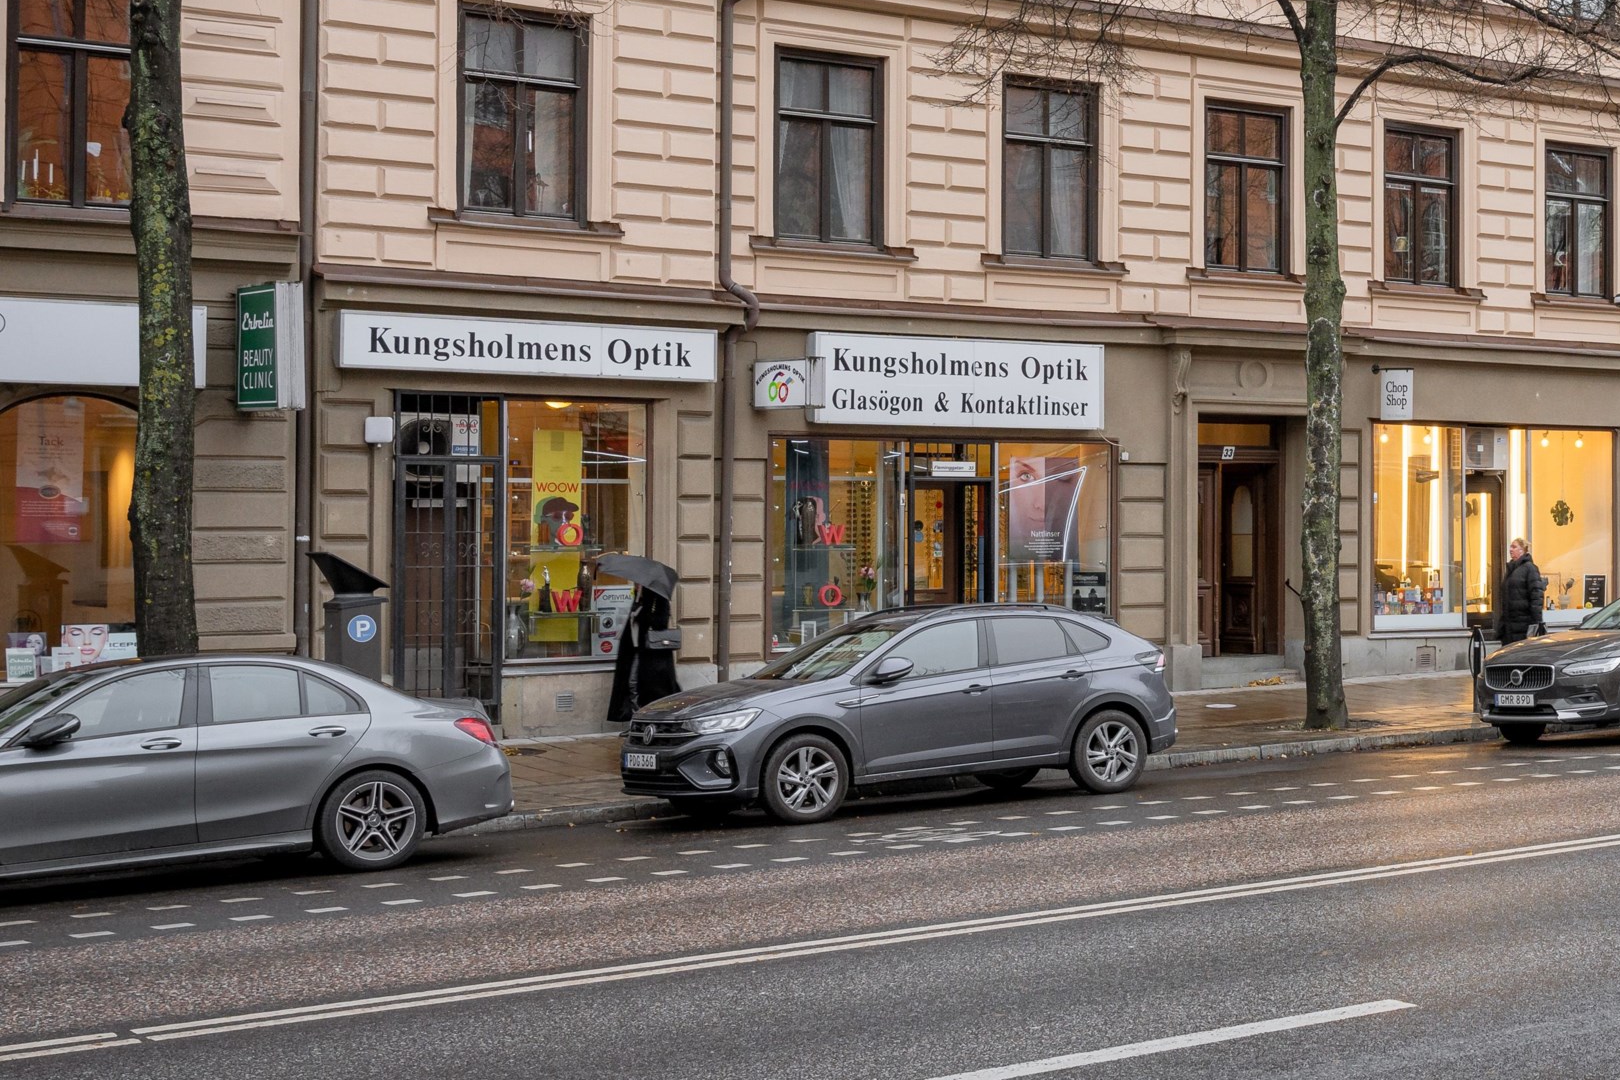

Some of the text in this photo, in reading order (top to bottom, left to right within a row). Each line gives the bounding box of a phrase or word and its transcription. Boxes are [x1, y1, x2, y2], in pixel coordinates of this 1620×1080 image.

[368, 326, 693, 371] Kungsholmens Optik
[243, 348, 274, 367] BEAUTY
[832, 347, 1089, 385] Kungsholmens Optik
[242, 370, 274, 390] CLINIC
[1385, 380, 1409, 397] Chop
[832, 387, 1089, 417] Glasögon & Kontaktlinser
[1386, 394, 1408, 410] Shop
[39, 435, 65, 446] Tack
[1223, 448, 1234, 458] 33
[536, 482, 580, 493] WOOW
[1030, 530, 1060, 538] Nattlinser
[356, 620, 370, 638] P
[1500, 695, 1531, 705] GMR 89D
[629, 754, 655, 768] PDG 36G
